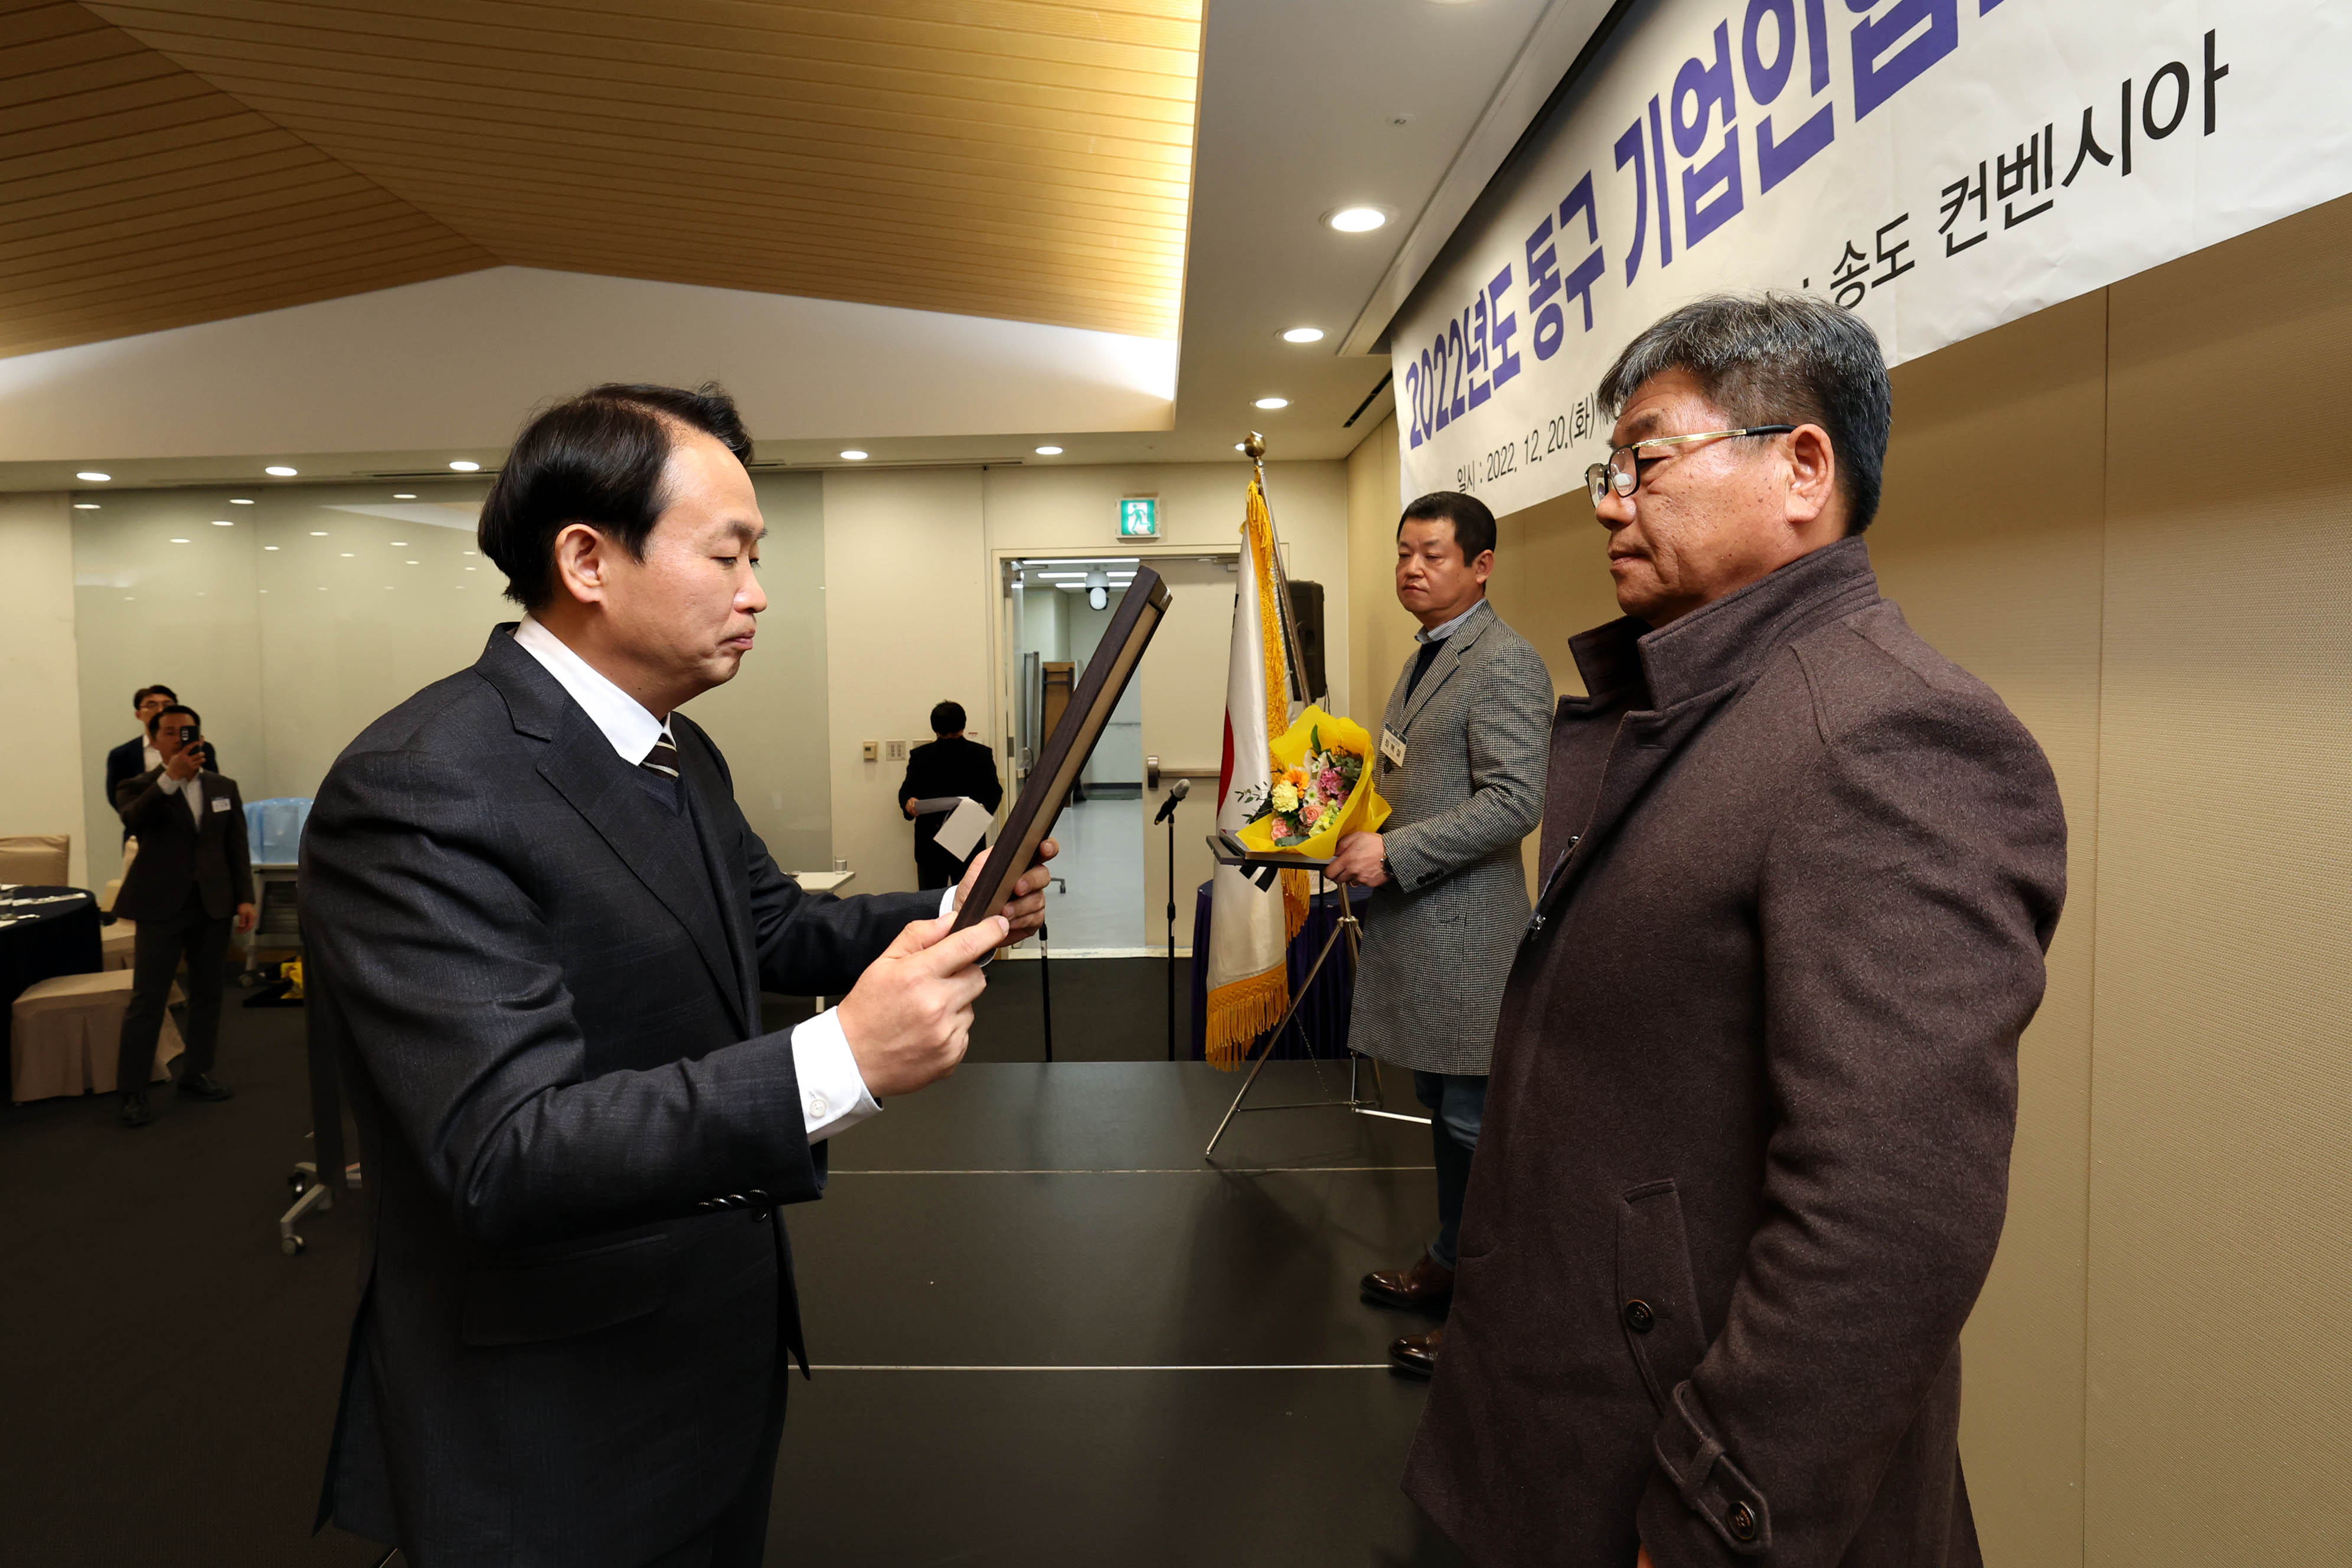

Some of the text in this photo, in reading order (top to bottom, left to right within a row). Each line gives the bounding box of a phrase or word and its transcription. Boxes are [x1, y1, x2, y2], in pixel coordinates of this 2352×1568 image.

[1406, 262, 1521, 450] 2022년도
[1525, 169, 1605, 361] 동구
[1830, 28, 2229, 310] 송도 컨벤시아
[1457, 460, 1475, 494] 일시
[1487, 442, 1517, 482] 2022.
[1524, 429, 1542, 465] 12.
[1547, 392, 1595, 454] 20.(화)
